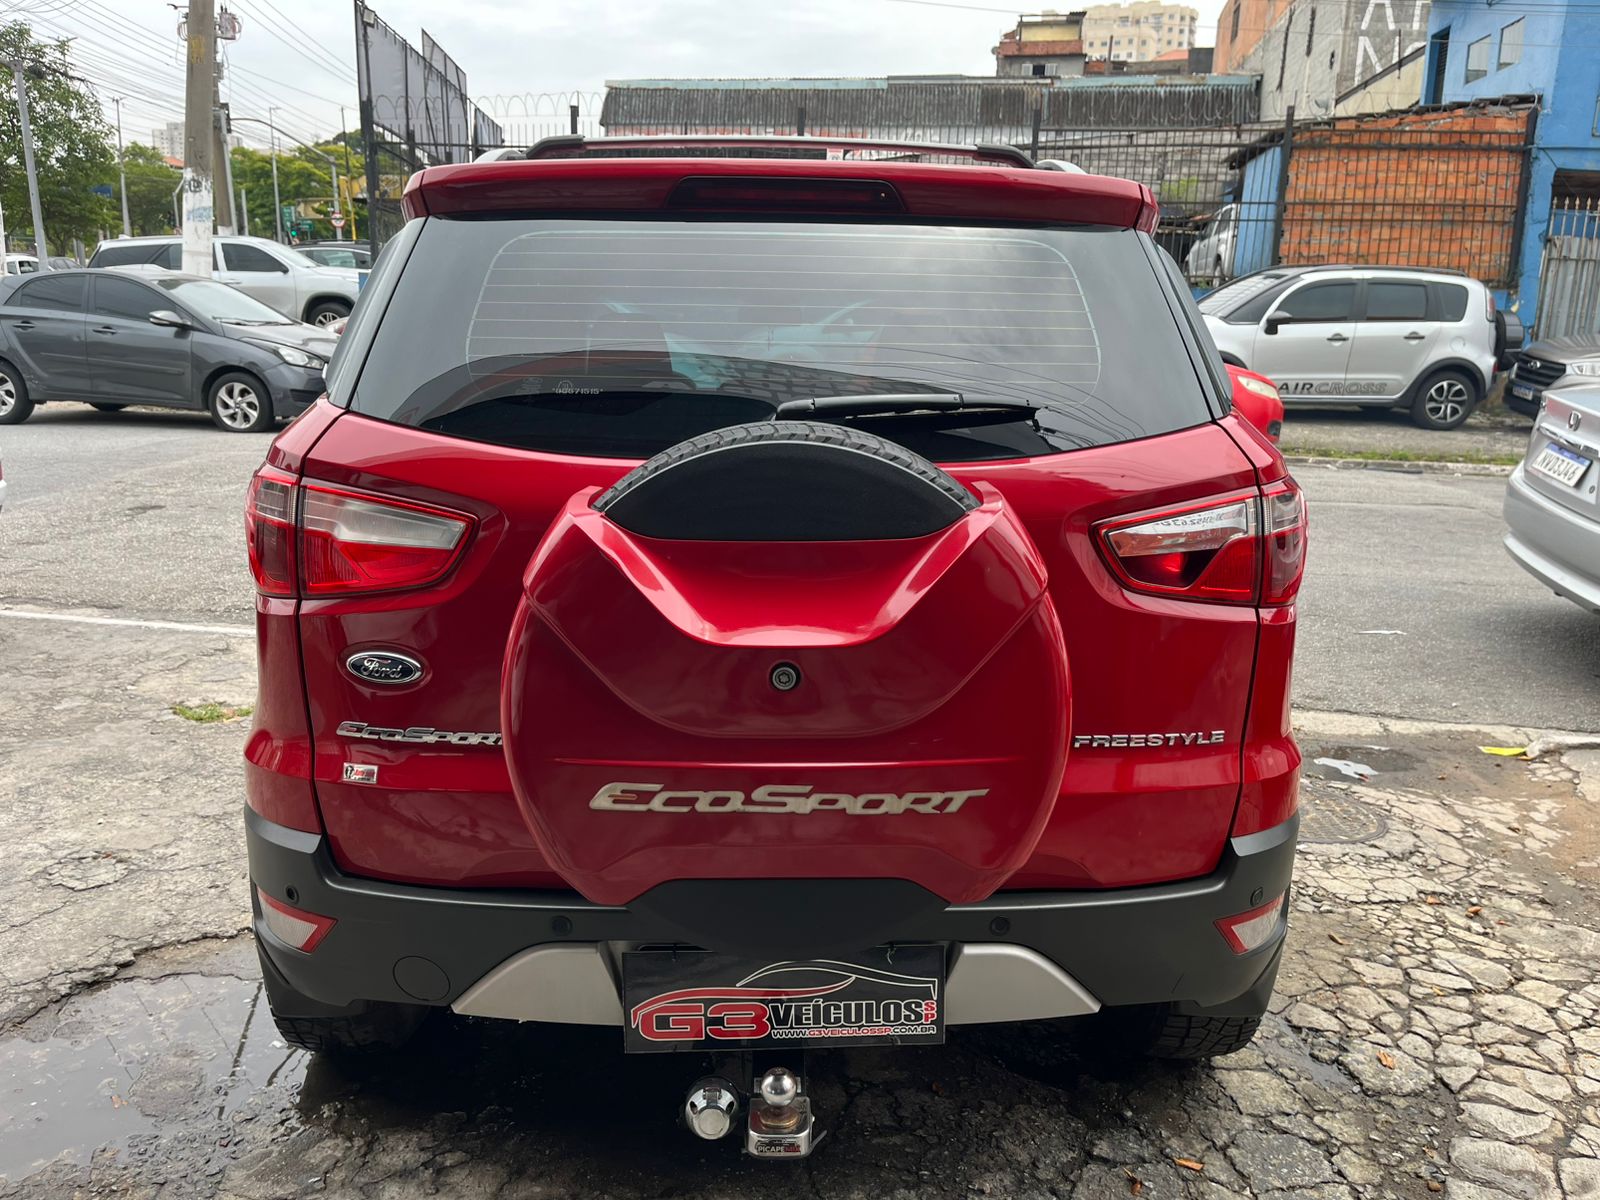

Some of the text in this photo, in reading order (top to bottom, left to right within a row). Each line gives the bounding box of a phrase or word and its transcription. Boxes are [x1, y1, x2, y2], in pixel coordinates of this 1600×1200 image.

[1279, 382, 1387, 394] AIRCROSS
[361, 657, 403, 679] Ford
[1074, 730, 1225, 748] FREESTYLE
[639, 1002, 771, 1041] G3
[769, 999, 925, 1028] VEÍCULOS
[771, 1025, 937, 1039] WWW.G3VEICULOSSP.COM.BR
